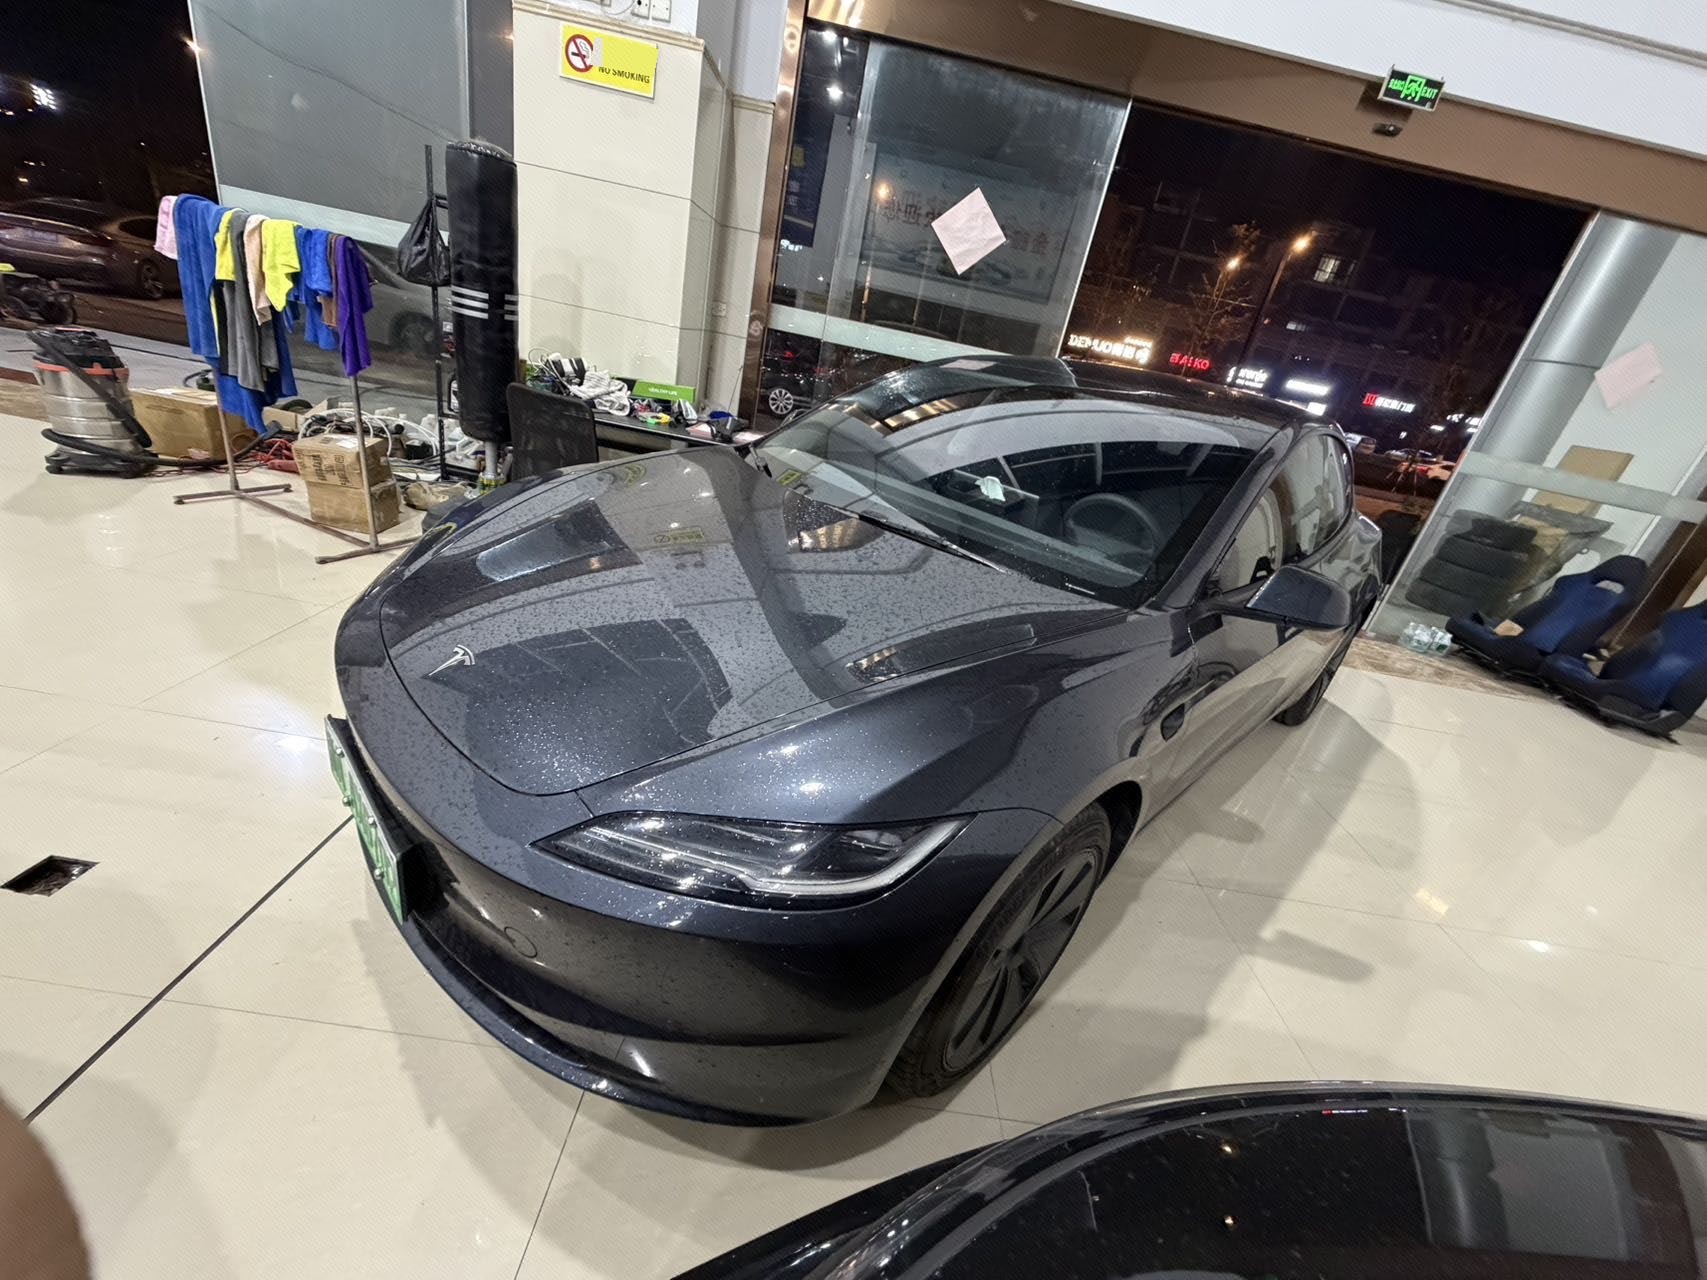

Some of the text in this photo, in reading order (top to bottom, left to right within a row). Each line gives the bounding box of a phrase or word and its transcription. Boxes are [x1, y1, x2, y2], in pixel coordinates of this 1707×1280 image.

[598, 66, 650, 84] NO SMOKING
[1421, 86, 1439, 99] EXIT
